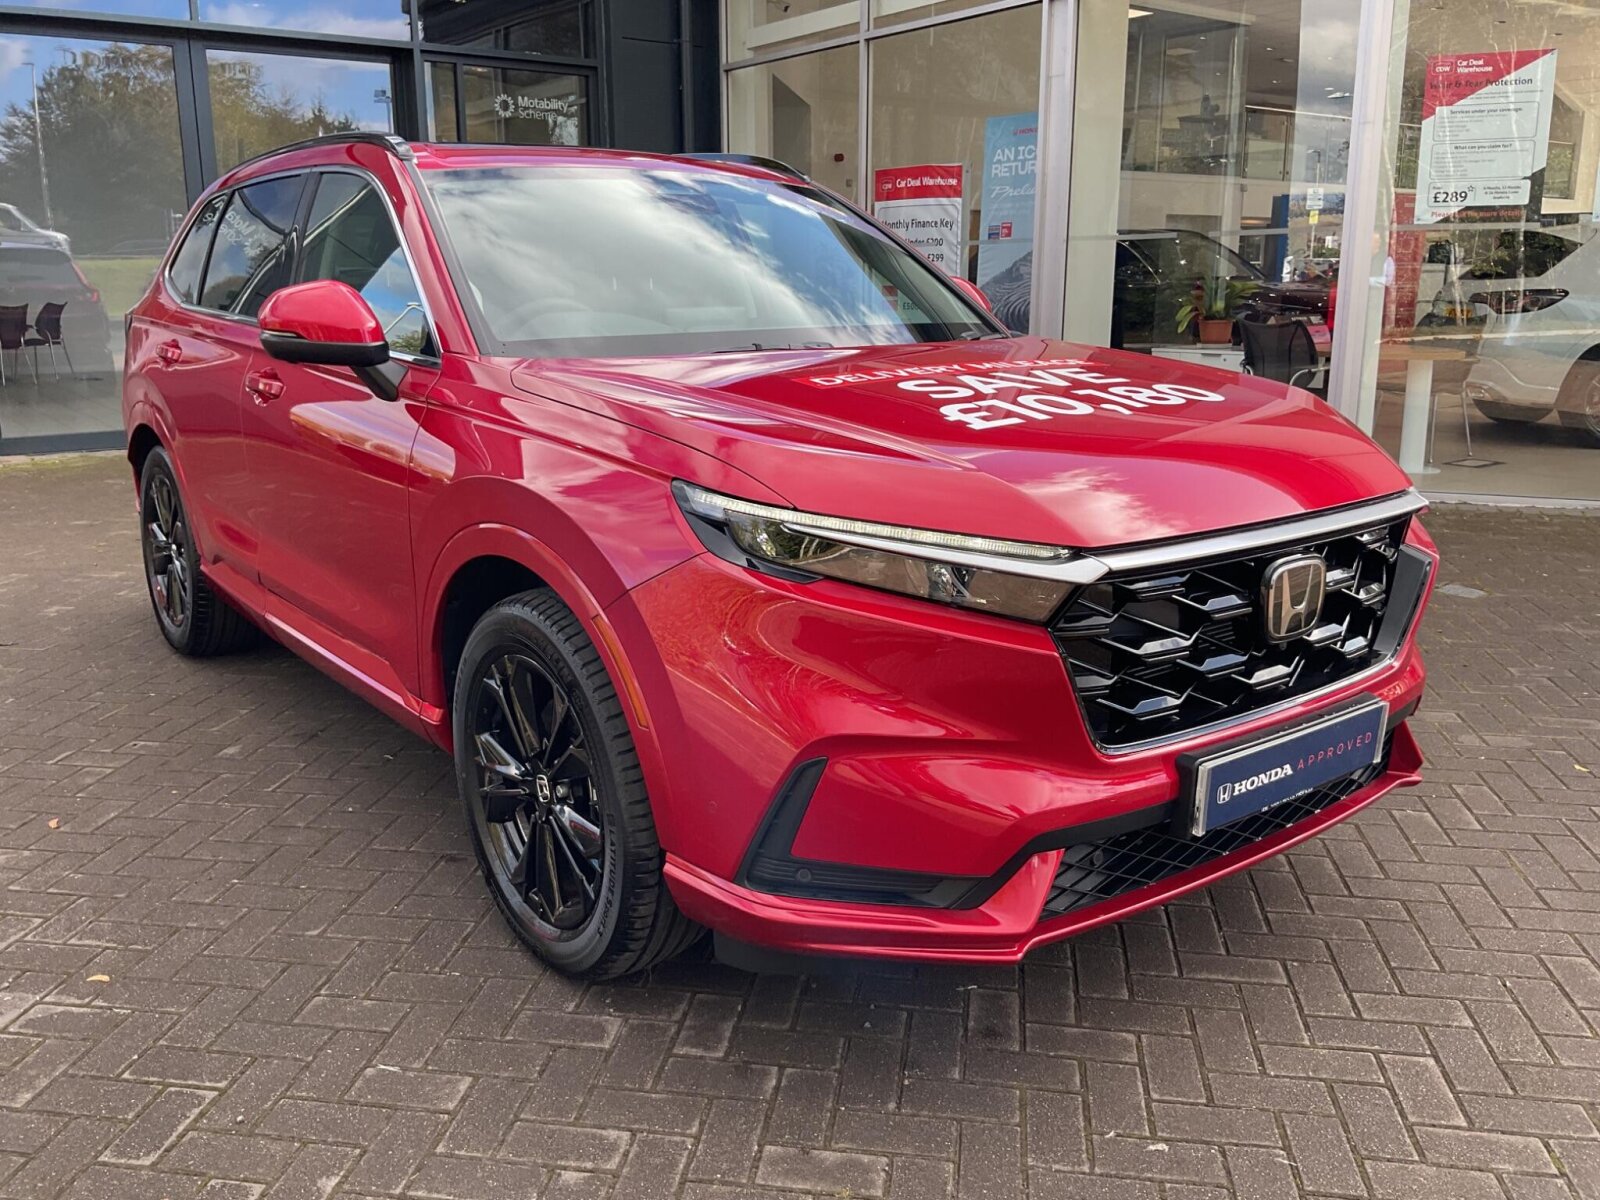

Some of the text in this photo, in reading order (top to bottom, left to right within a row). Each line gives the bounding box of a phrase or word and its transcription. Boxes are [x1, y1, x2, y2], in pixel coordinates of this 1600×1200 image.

[1469, 58, 1484, 66] Deal
[1456, 65, 1494, 74] Warehouse
[1464, 79, 1484, 88] Tear
[1485, 77, 1533, 88] Protection
[517, 95, 569, 113] Motability
[518, 108, 558, 120] Scheme
[1499, 107, 1523, 115] coveage:
[993, 147, 1015, 163] AN
[896, 178, 907, 188] Car
[907, 177, 921, 187] Deal
[922, 175, 958, 186] Warehouse
[1433, 190, 1468, 204] £289
[1499, 209, 1522, 217] detail
[911, 218, 939, 229] Finance
[940, 218, 955, 231] Key
[810, 358, 1095, 387] DELIVERY MILEAGE
[897, 367, 1131, 400] SAVE
[938, 383, 1227, 431] £10,180
[1233, 764, 1294, 797] HONDA
[1297, 731, 1372, 770] APPROVED
